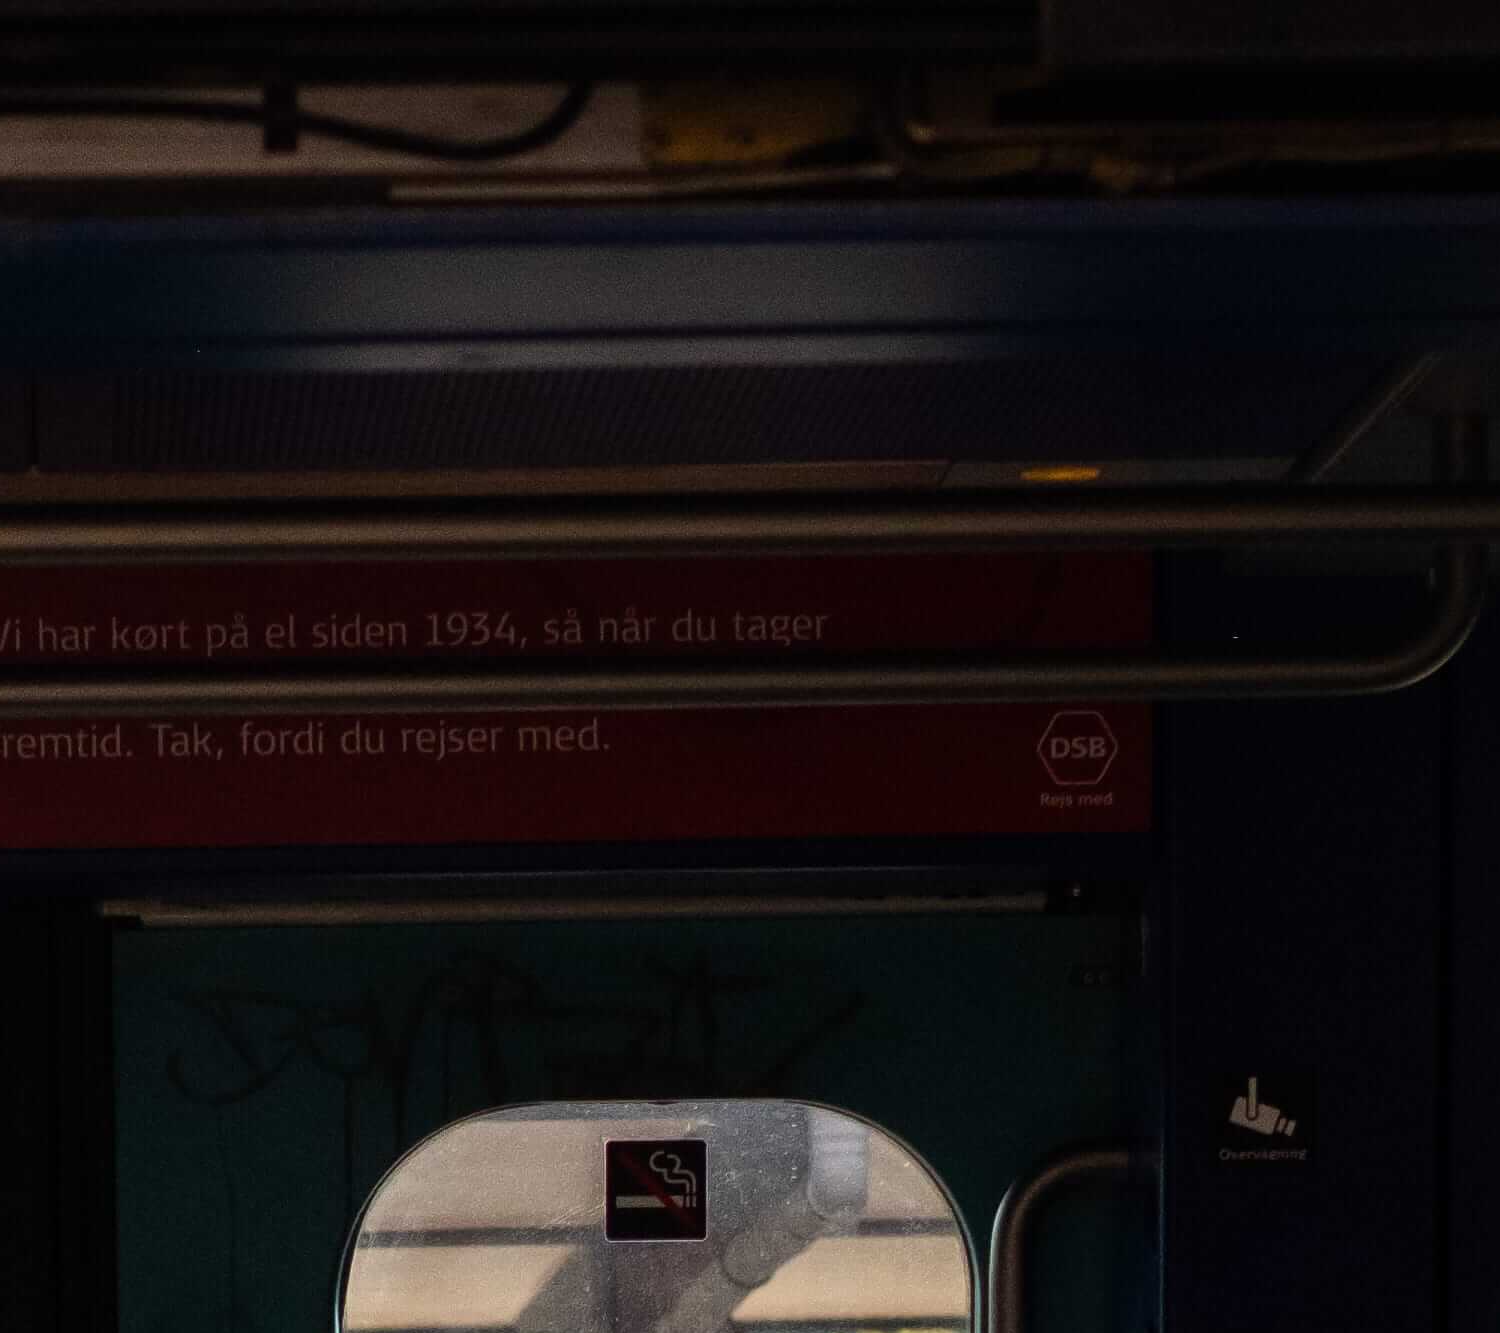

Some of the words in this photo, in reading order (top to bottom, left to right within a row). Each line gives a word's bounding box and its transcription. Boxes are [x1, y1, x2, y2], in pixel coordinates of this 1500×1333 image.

[38, 616, 97, 652] har
[111, 615, 191, 651] kørt
[205, 611, 249, 657] på
[264, 611, 297, 649] el
[312, 613, 408, 650] siden
[425, 611, 528, 651] 1934,
[543, 607, 585, 646] så
[598, 605, 657, 645] når
[671, 609, 717, 645] du
[731, 611, 828, 648] tager
[147, 722, 225, 766] Tak,
[239, 719, 326, 760] fordi
[339, 720, 385, 756] du
[400, 719, 503, 761] rejser
[518, 717, 611, 755] med.
[1050, 735, 1107, 760] DSB
